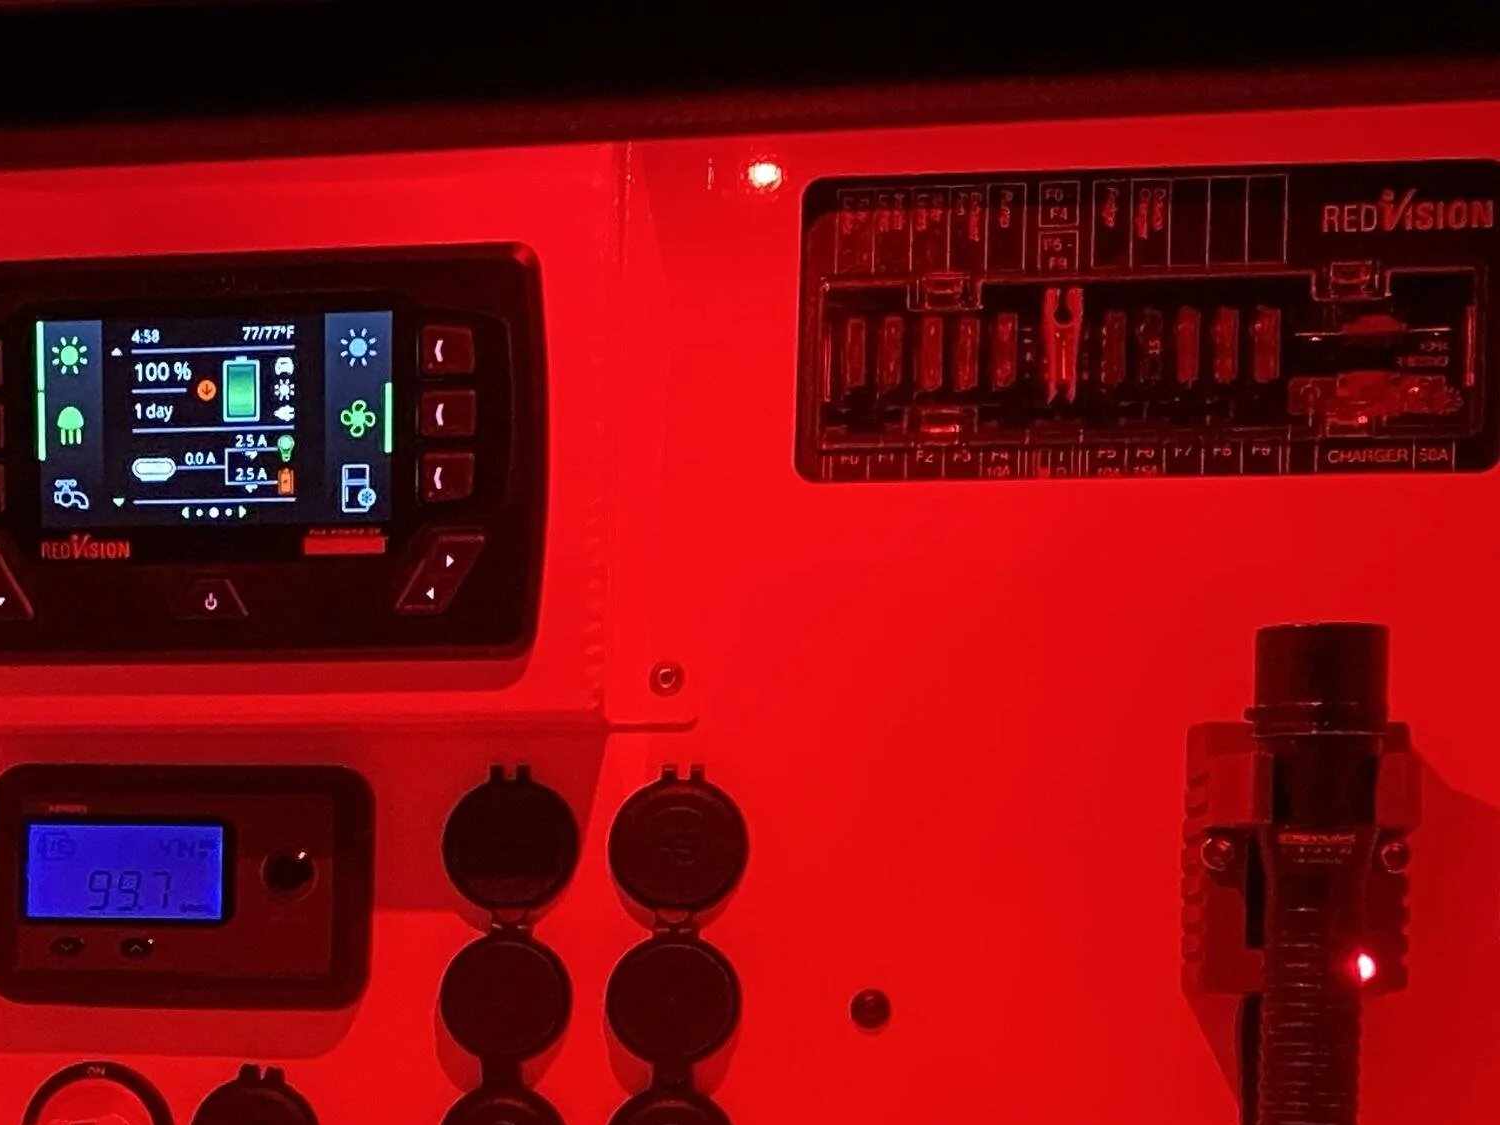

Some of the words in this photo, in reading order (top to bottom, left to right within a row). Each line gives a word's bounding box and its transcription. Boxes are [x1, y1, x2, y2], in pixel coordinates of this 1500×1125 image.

[131, 328, 160, 344] 4:58
[242, 325, 295, 341] 77/77°F
[134, 361, 170, 382] 100
[173, 361, 192, 381] %
[134, 403, 142, 420] 1
[146, 403, 174, 423] day
[235, 434, 255, 448] 2.5
[257, 434, 268, 448] A
[185, 452, 204, 465] 0.0
[206, 451, 216, 464] A
[1327, 449, 1409, 464] CHARGER
[235, 467, 255, 481] 2.5
[257, 467, 268, 480] A
[88, 870, 172, 911] 99.7
